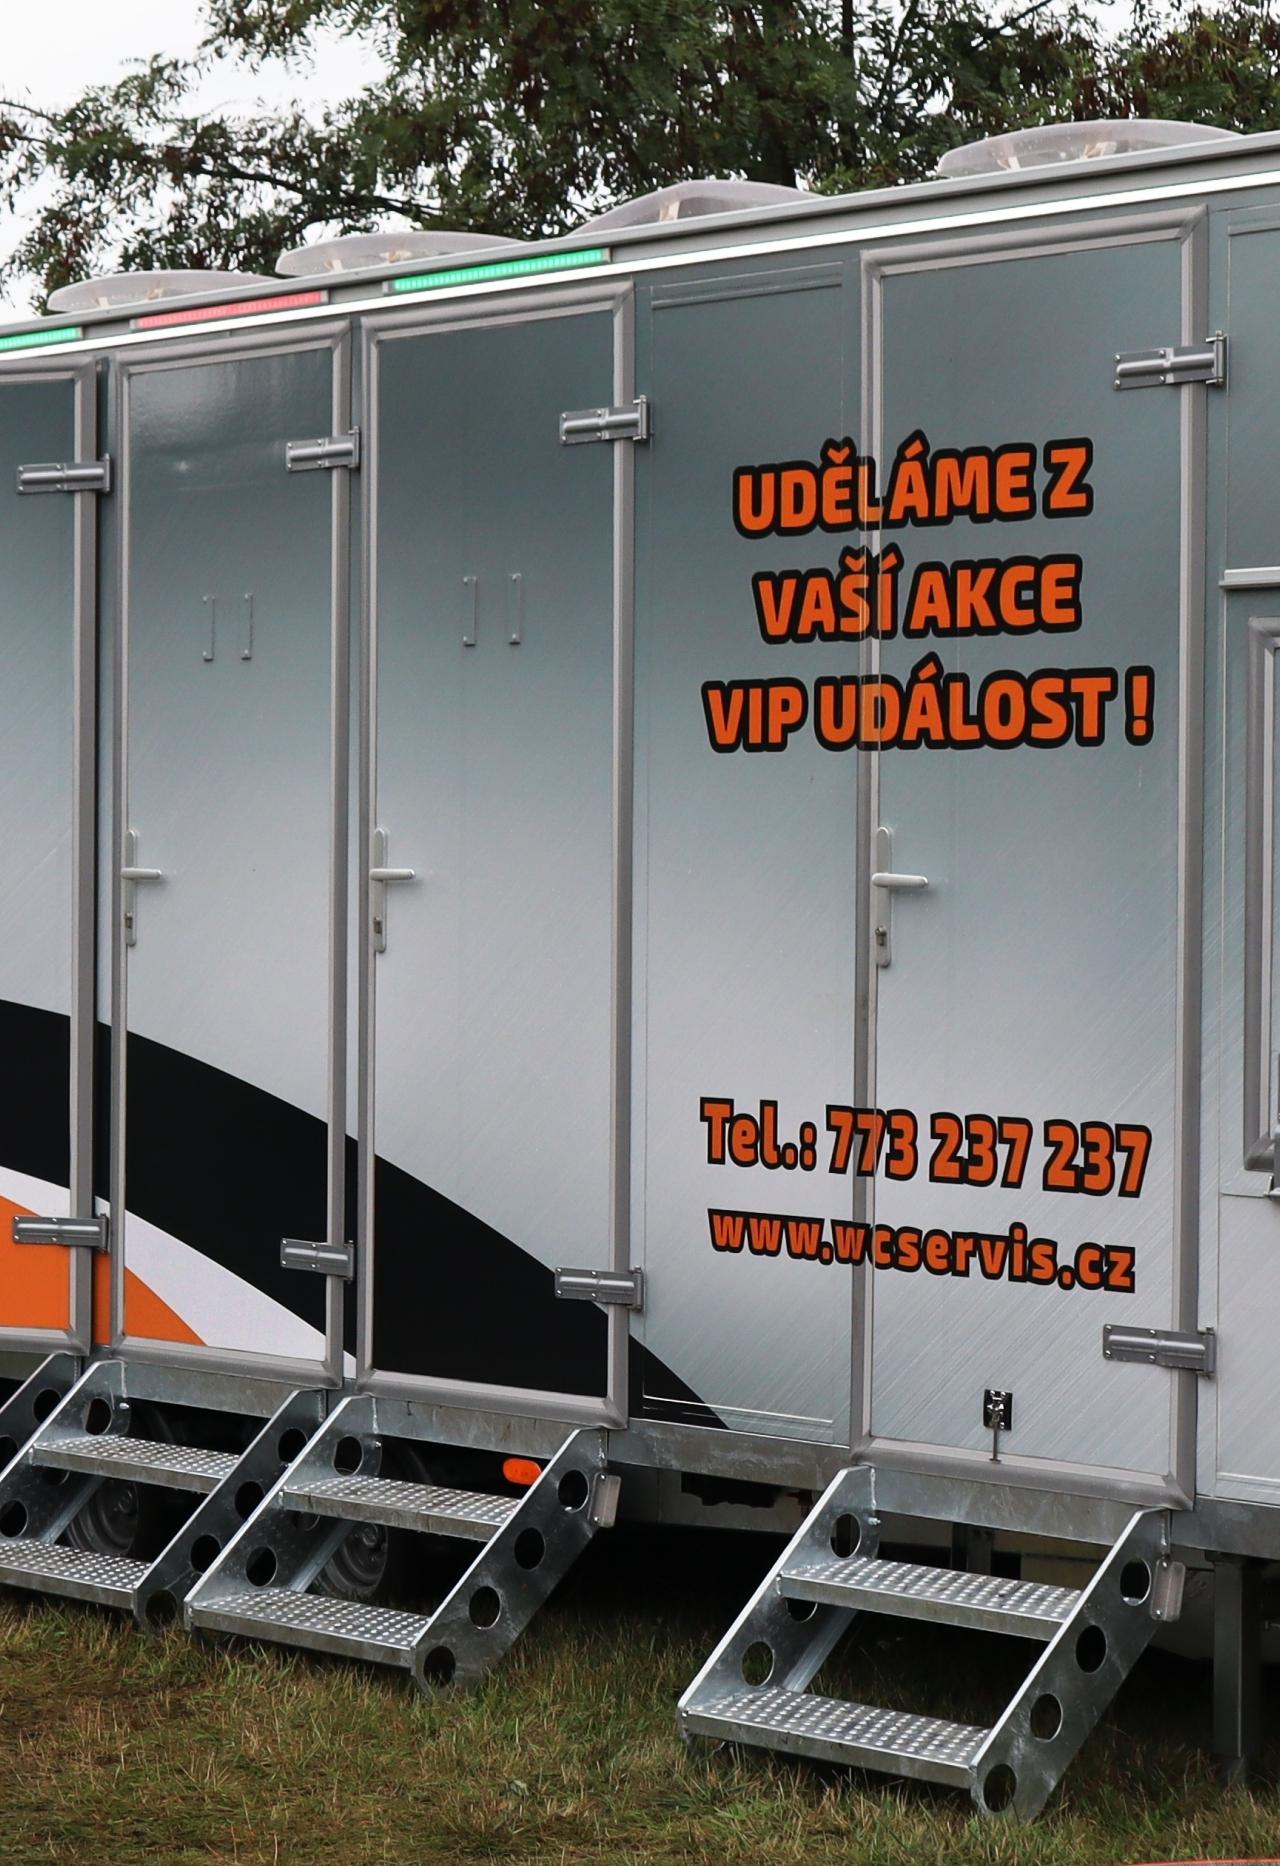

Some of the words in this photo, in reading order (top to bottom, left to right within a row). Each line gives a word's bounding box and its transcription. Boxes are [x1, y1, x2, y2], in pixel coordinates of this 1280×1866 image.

[733, 429, 1037, 539] UDĚLÁME
[1044, 437, 1093, 518] Z
[753, 543, 904, 645] VAŠÍ
[905, 554, 1083, 639] AKCE
[702, 677, 808, 753] VIP
[814, 652, 1118, 751] UDÁLOST
[1124, 665, 1155, 746] !
[700, 1097, 816, 1171] Tel.:
[825, 1104, 918, 1181] 773
[929, 1112, 1033, 1188] 237
[1043, 1117, 1152, 1198] 237
[707, 1208, 1136, 1293] www.wcservis.cz
